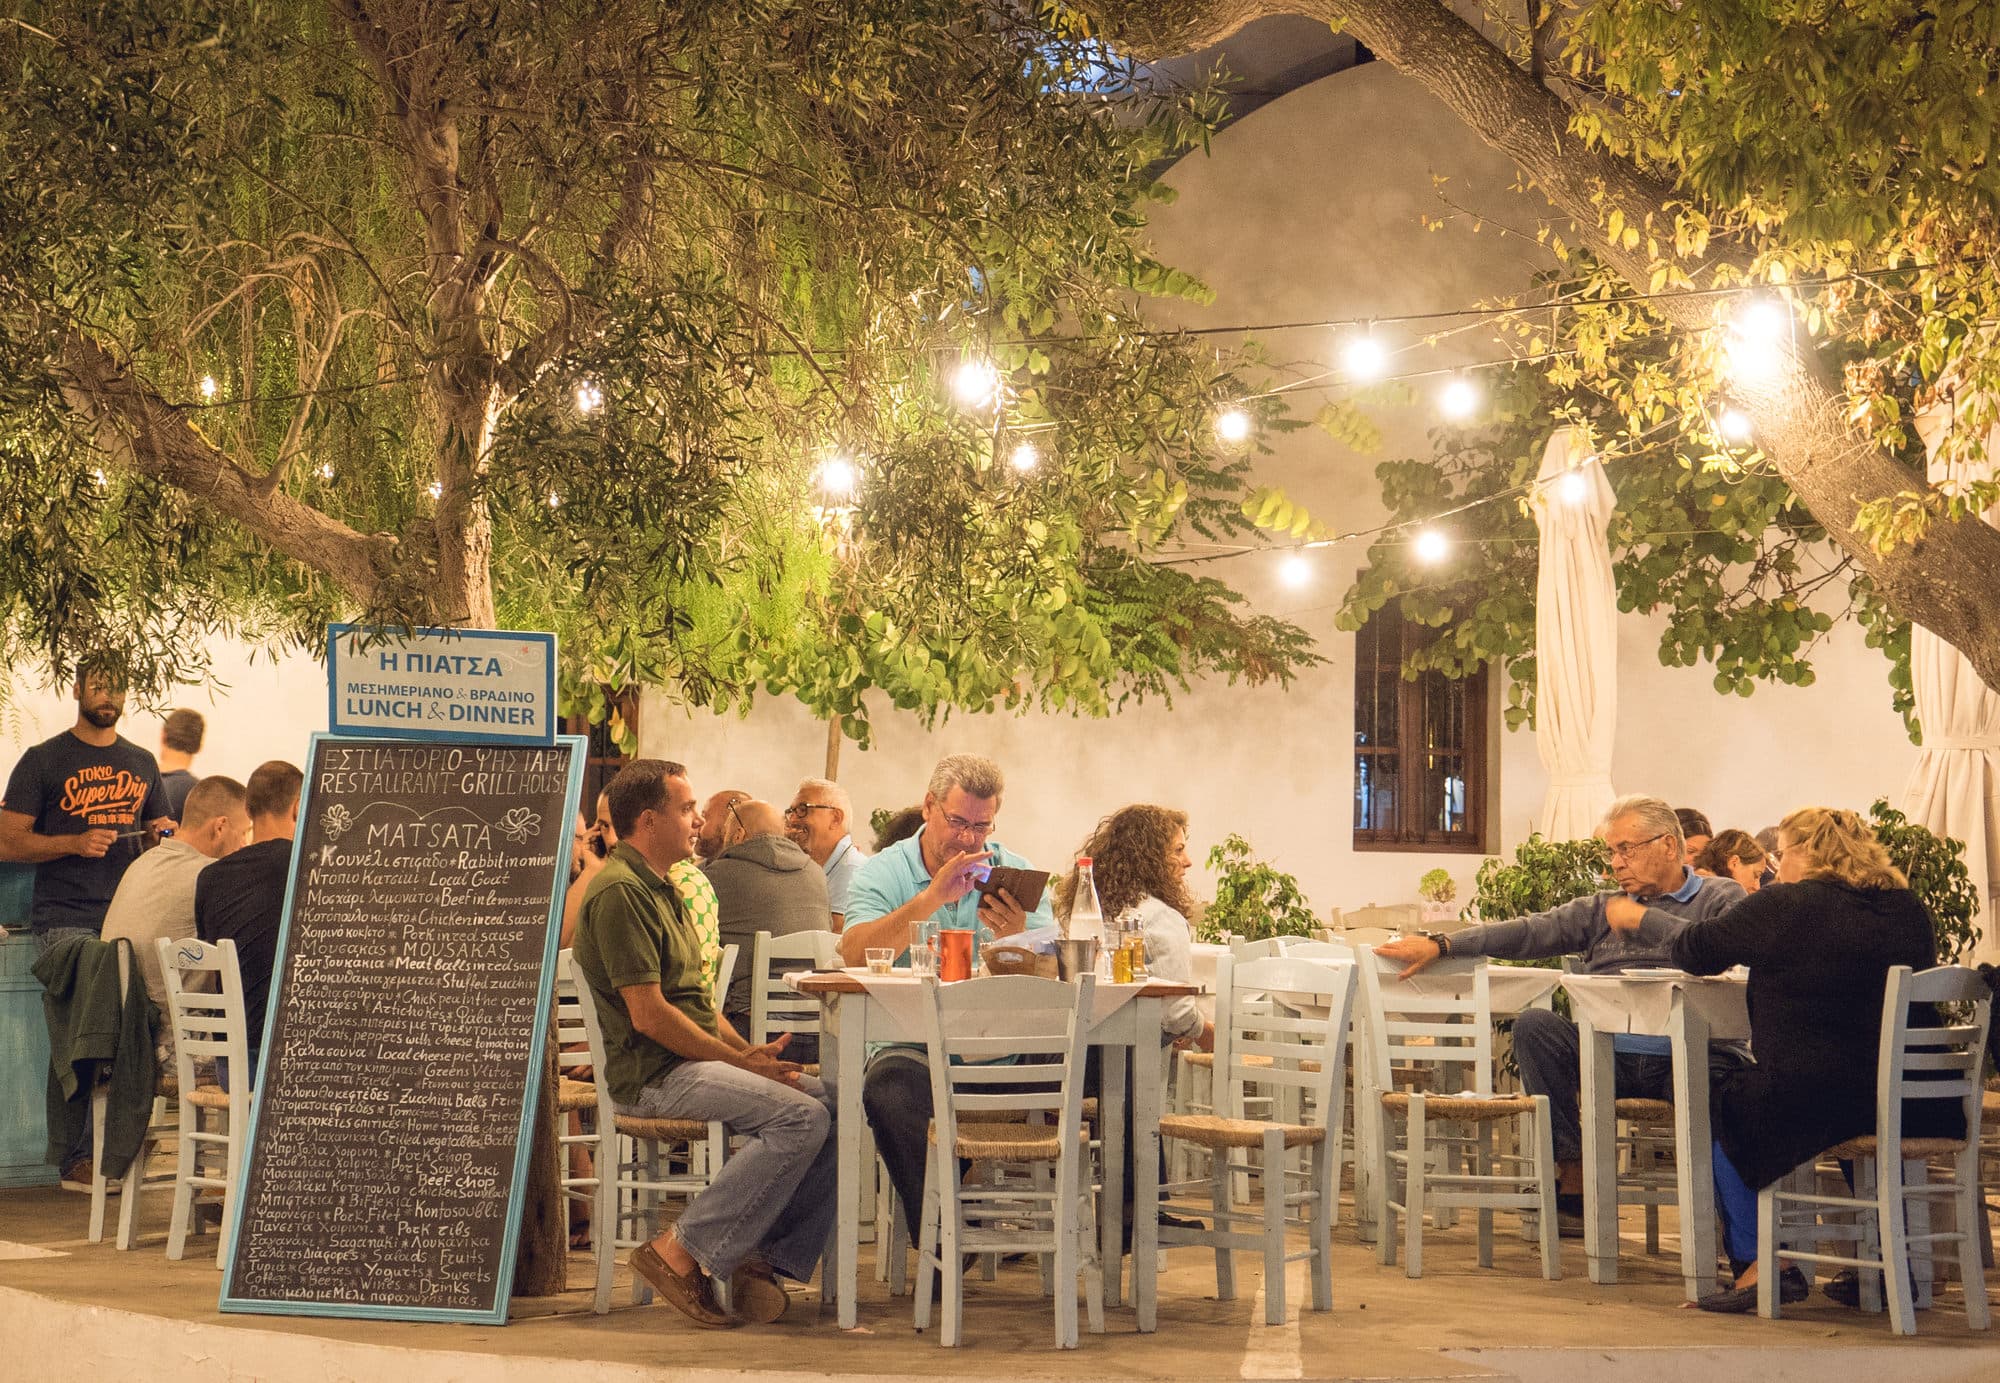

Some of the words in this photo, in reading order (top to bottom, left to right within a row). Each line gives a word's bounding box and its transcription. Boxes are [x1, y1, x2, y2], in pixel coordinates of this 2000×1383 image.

[406, 653, 503, 677] ΠΙΑΤΣΑ
[347, 682, 454, 699] ΜΕΣΗΜΕΡΙΑΝΟ
[456, 688, 467, 700] &
[470, 689, 535, 704] ΒΡΑΔΙΝΟ
[347, 698, 422, 719] LUNCH
[427, 701, 445, 721] &
[449, 704, 535, 725] DINNER
[78, 764, 115, 784] TOKYO
[367, 823, 492, 850] MATSATA
[429, 871, 469, 886] Local
[472, 871, 510, 887] Goat
[403, 925, 435, 941] Pork
[480, 931, 523, 942] sause
[404, 942, 510, 958] MOUSAKAS
[396, 956, 432, 970] Meat
[501, 997, 536, 1006] oven
[435, 1036, 473, 1046] cheese
[377, 1044, 413, 1060] Local
[400, 1088, 453, 1106] Zucchini
[455, 1094, 487, 1108] Balls
